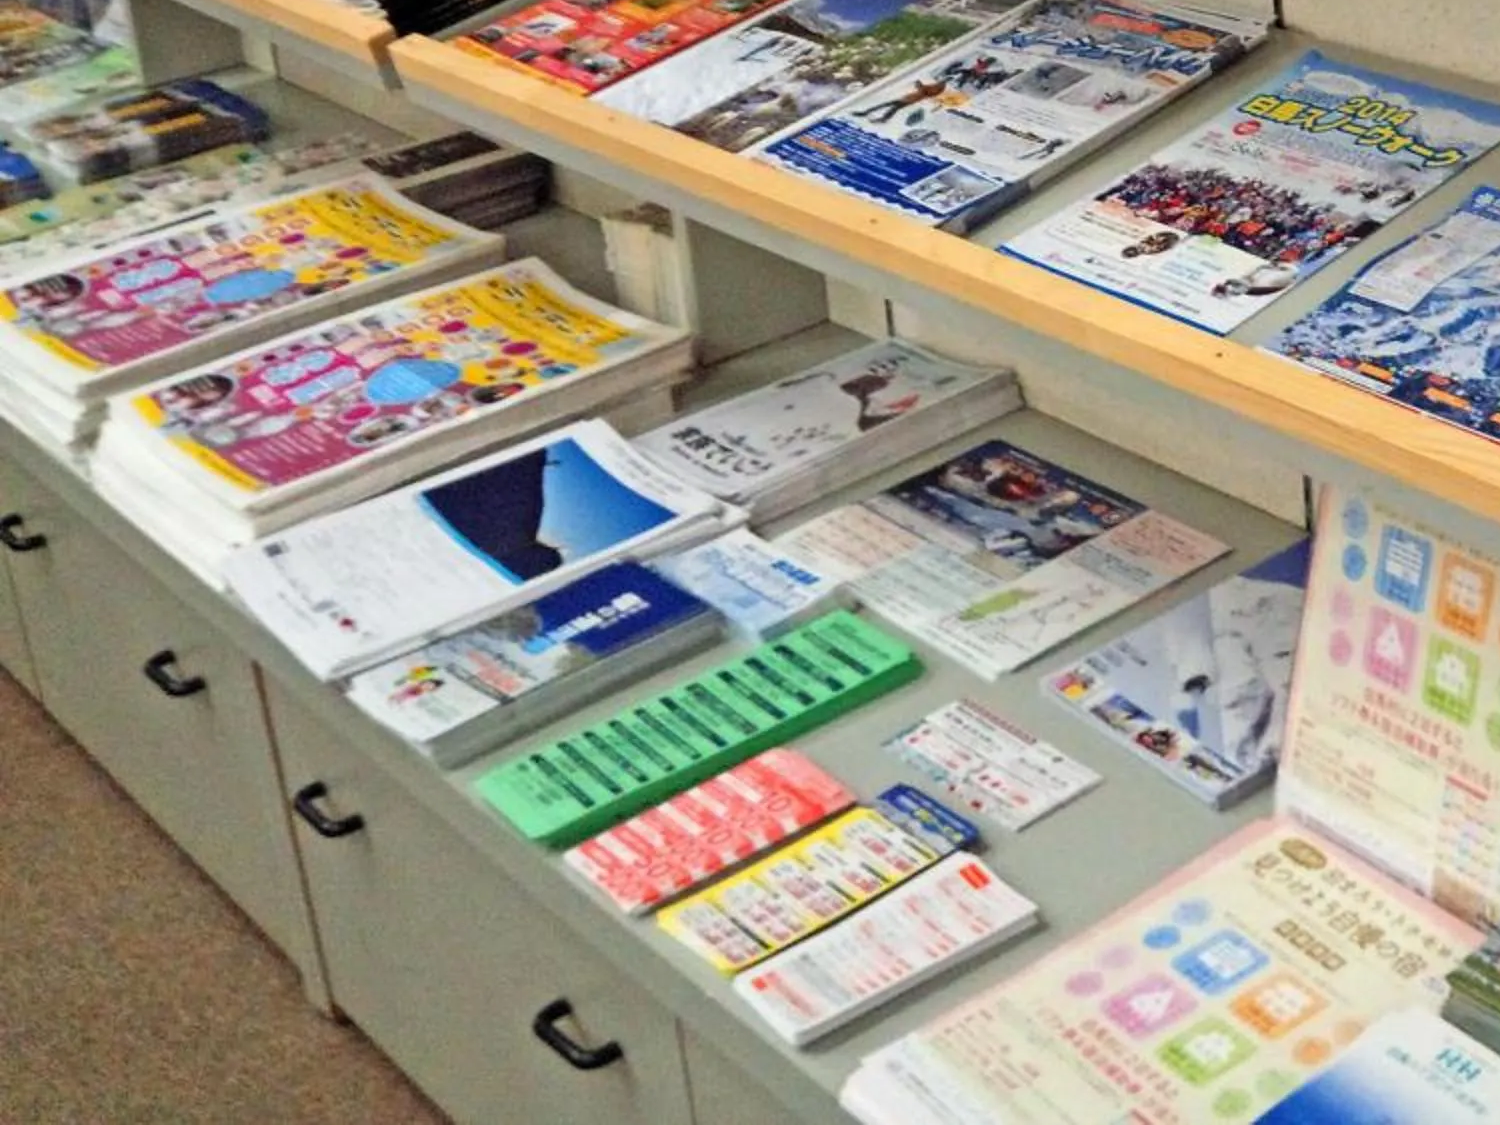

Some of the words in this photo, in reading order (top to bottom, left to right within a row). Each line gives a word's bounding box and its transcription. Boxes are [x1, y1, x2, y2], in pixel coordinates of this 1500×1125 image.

[1237, 93, 1468, 168] 白馬スノーウォーク
[1341, 95, 1416, 125] 2014
